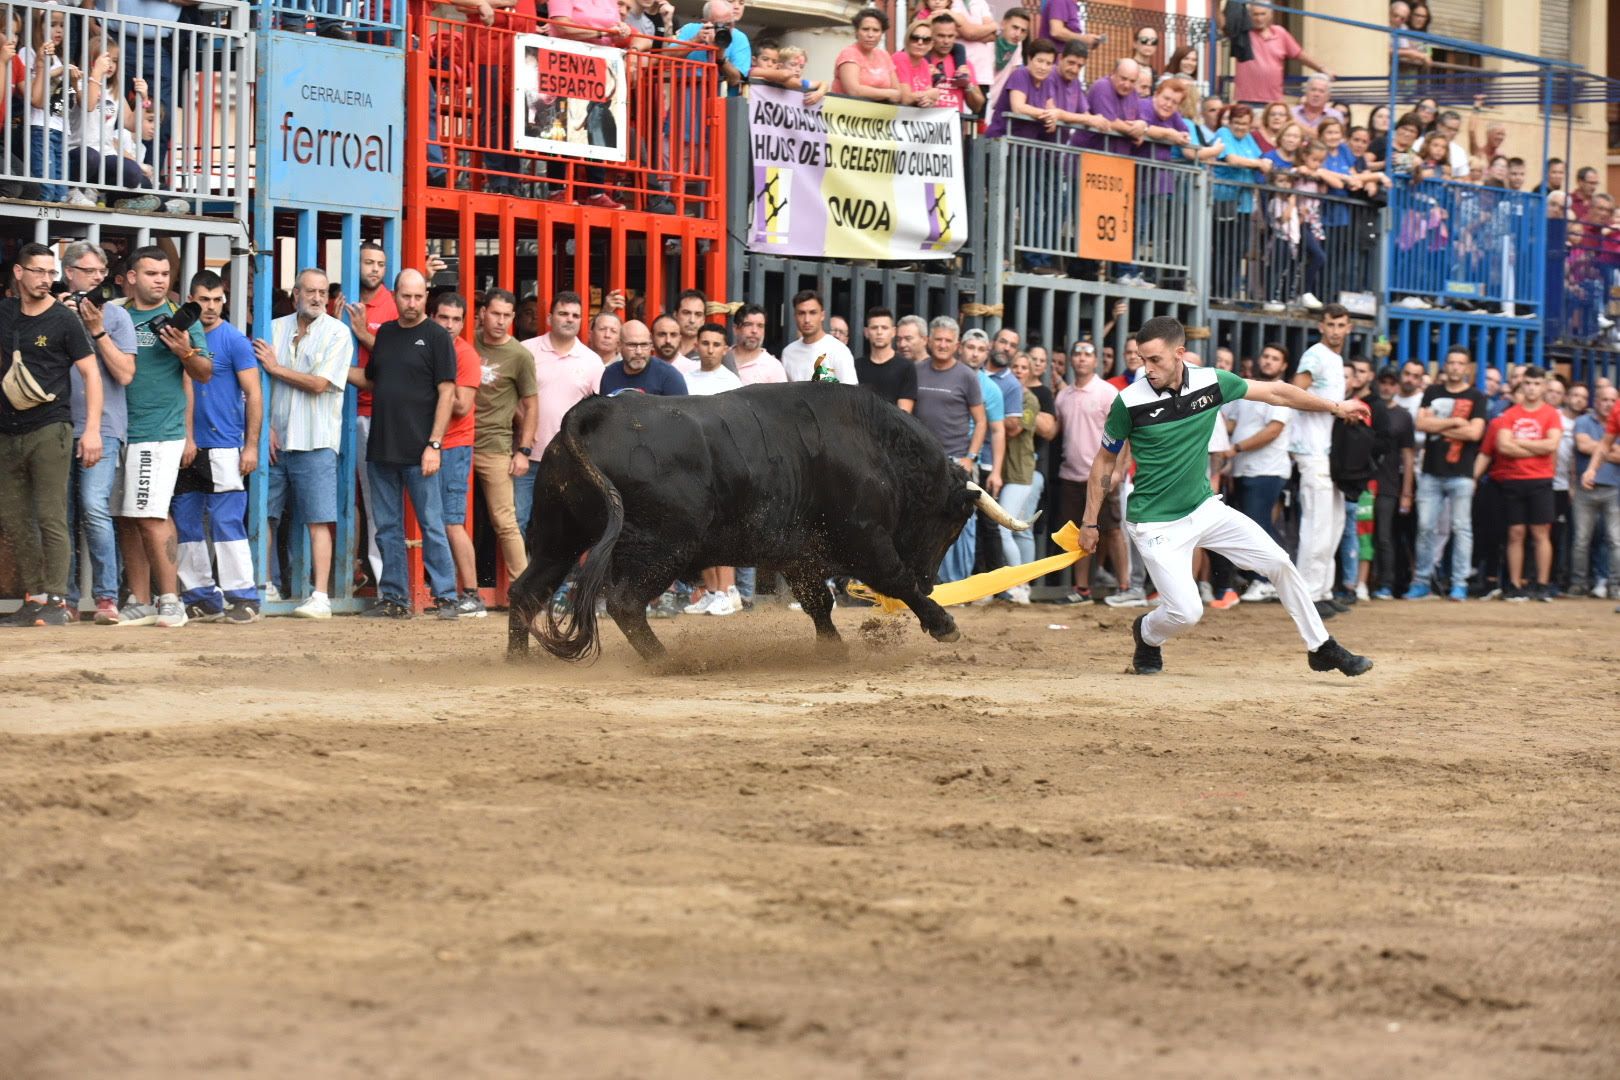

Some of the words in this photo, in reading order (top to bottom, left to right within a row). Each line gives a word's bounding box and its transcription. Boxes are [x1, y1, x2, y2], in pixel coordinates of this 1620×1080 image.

[548, 52, 597, 77] PENYA
[301, 84, 373, 108] CERRAJERIA
[540, 73, 606, 99] ESPARTO
[753, 100, 837, 135] ASOCIACIÓN
[837, 114, 903, 141] CULTURAL
[901, 119, 953, 146] TAURINA
[280, 111, 393, 173] ferroal
[755, 134, 795, 163] HIJOS
[798, 140, 821, 166] DE
[824, 143, 838, 168] D.
[840, 145, 907, 175] CELESTINO
[908, 151, 953, 178] CUADRI
[828, 196, 891, 231] ONDA
[1096, 215, 1116, 241] 93
[136, 450, 152, 506] HOLLISTER
